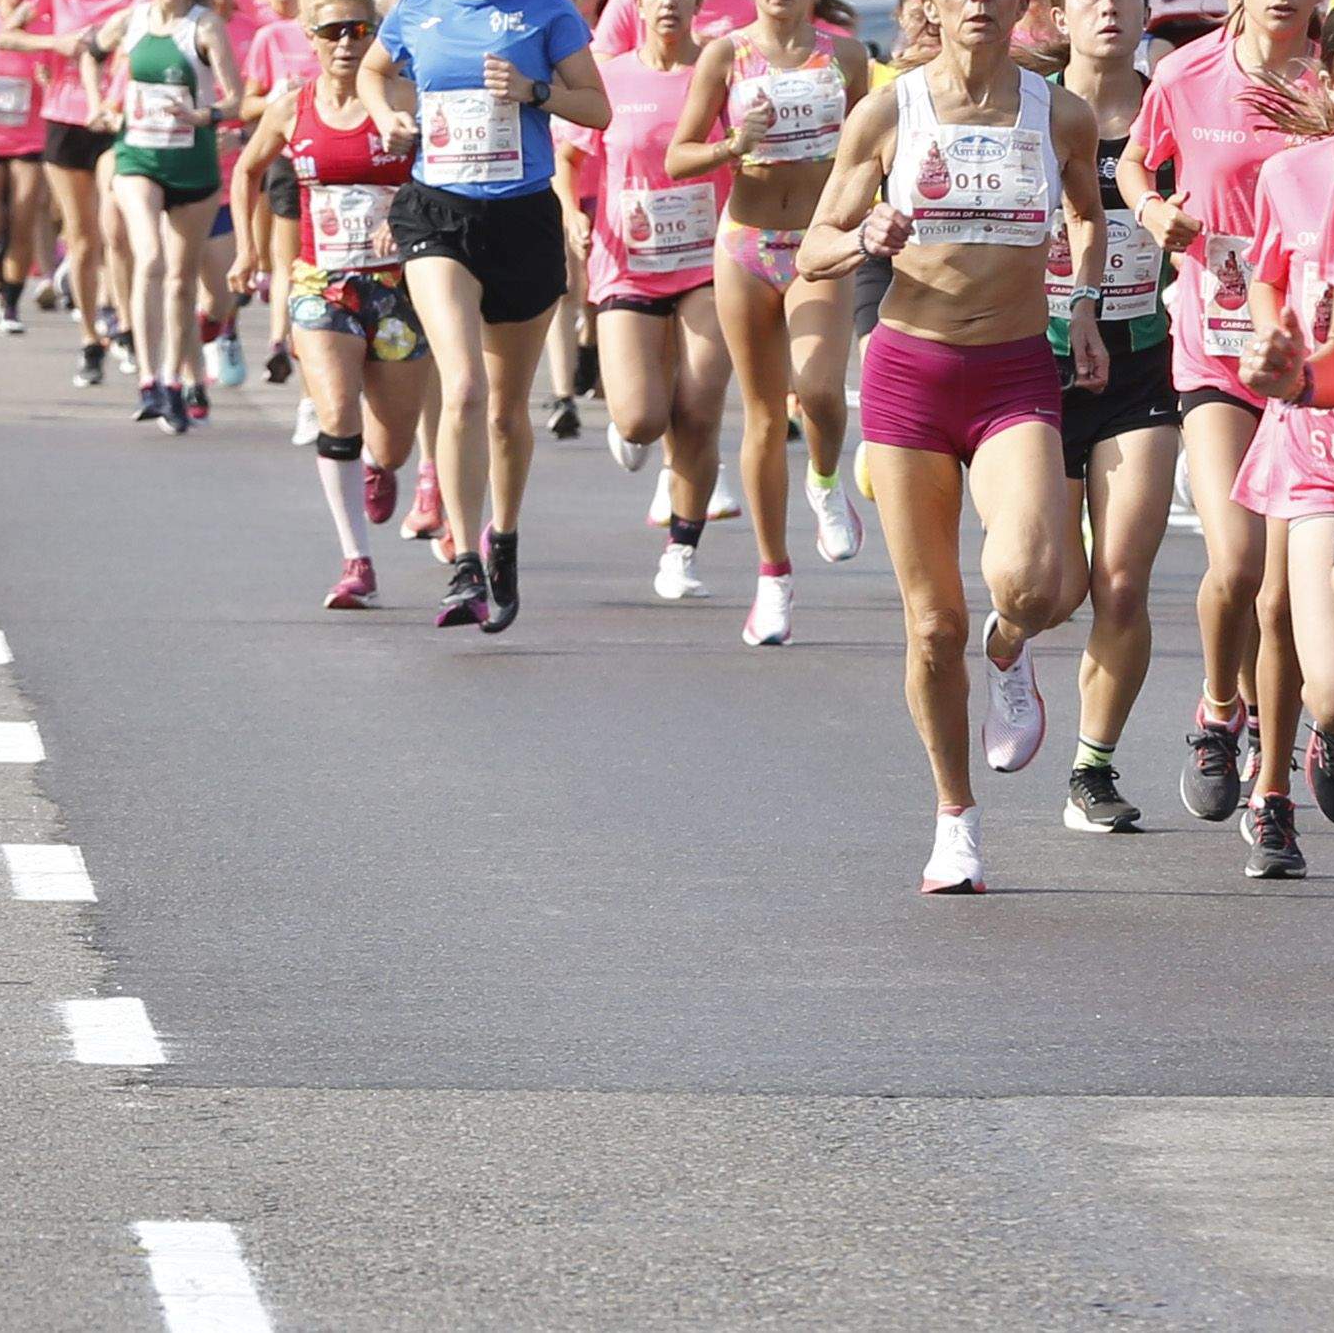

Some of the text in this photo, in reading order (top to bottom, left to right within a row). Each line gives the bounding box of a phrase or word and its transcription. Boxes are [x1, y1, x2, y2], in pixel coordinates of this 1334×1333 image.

[780, 104, 813, 120] 016
[453, 126, 486, 140] 016
[1192, 127, 1246, 144] OYSHO
[955, 173, 1002, 190] 016
[974, 196, 983, 207] 5
[655, 220, 687, 235] 016
[919, 224, 961, 236] OYSHO
